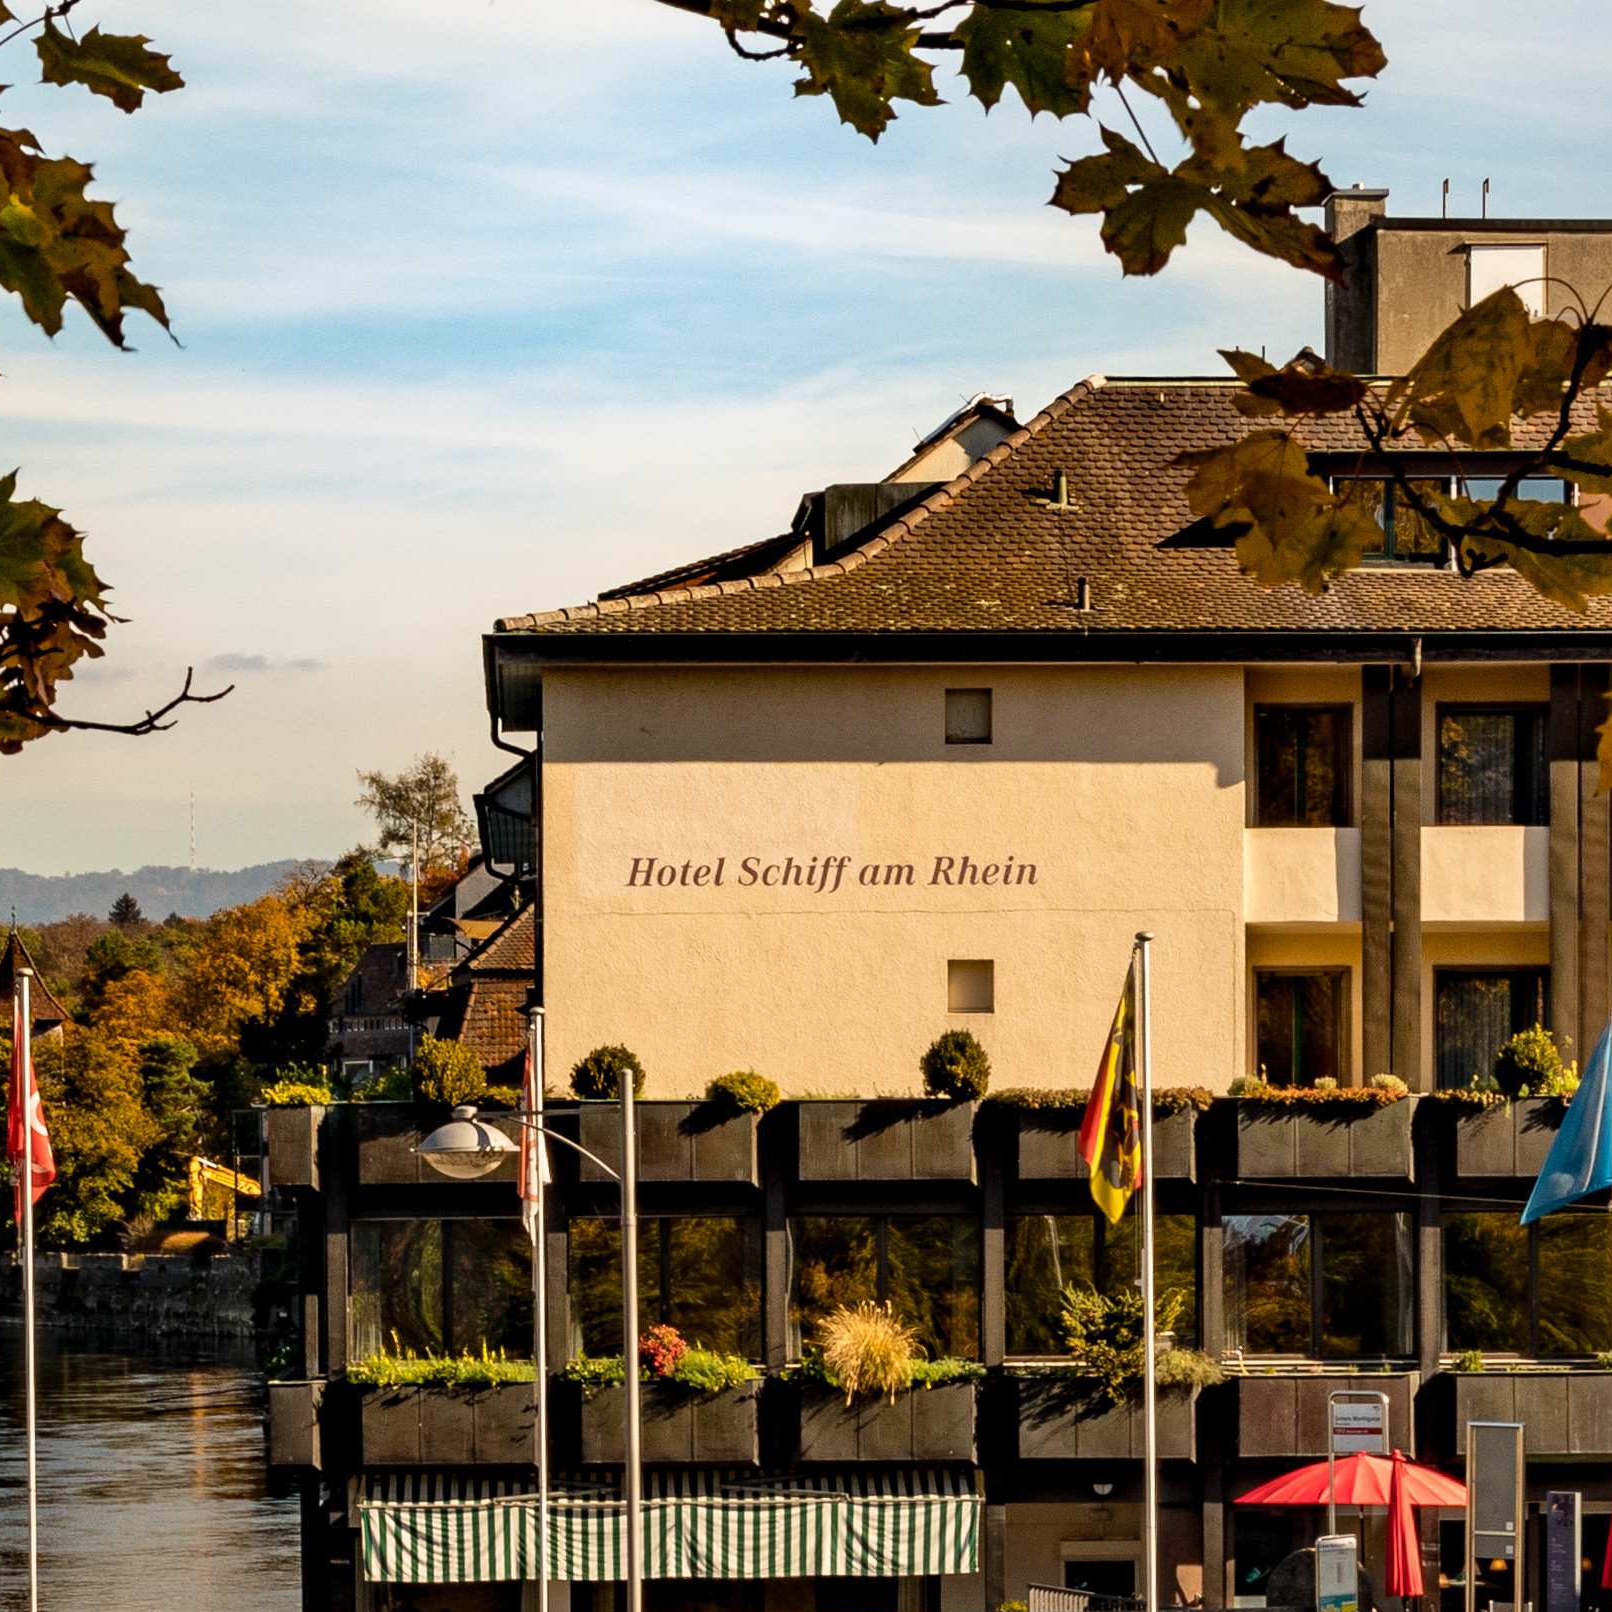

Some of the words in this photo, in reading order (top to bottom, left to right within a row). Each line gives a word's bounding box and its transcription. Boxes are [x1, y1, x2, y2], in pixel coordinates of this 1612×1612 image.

[625, 856, 726, 887] Hotel
[737, 855, 851, 893] Schiff
[858, 863, 915, 886] am
[927, 855, 1038, 886] Rhein
